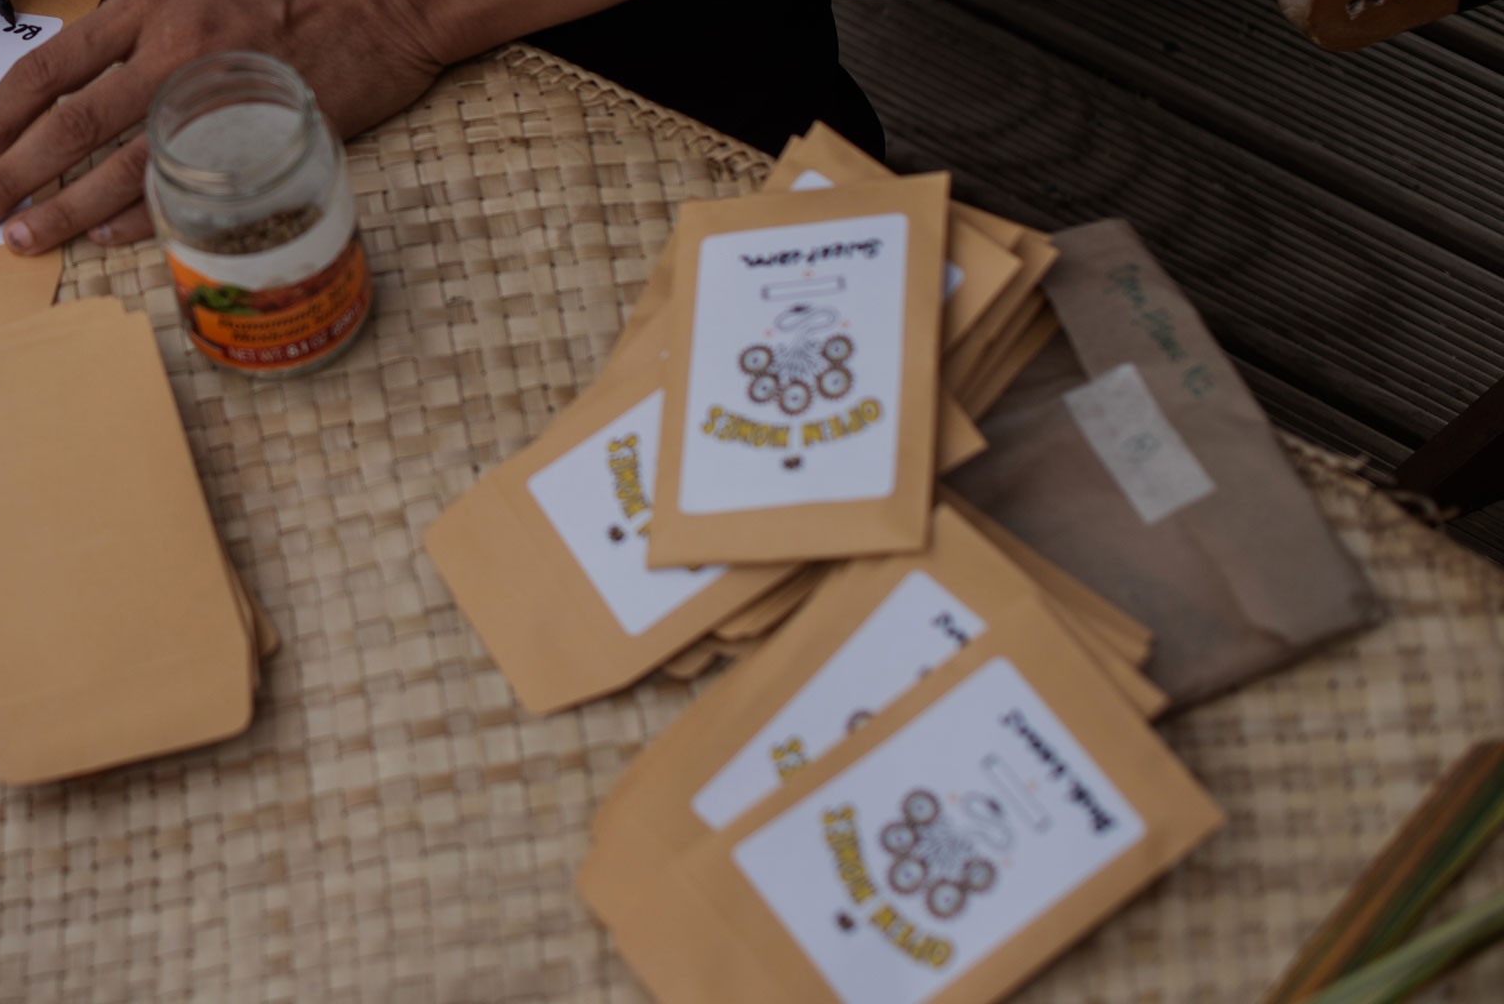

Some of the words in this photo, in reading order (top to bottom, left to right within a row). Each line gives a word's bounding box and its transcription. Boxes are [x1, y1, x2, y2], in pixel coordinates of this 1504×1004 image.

[700, 404, 791, 448] HOMES
[802, 397, 883, 447] OPEN
[820, 804, 878, 906] HOMES
[870, 902, 957, 970] OPEN
